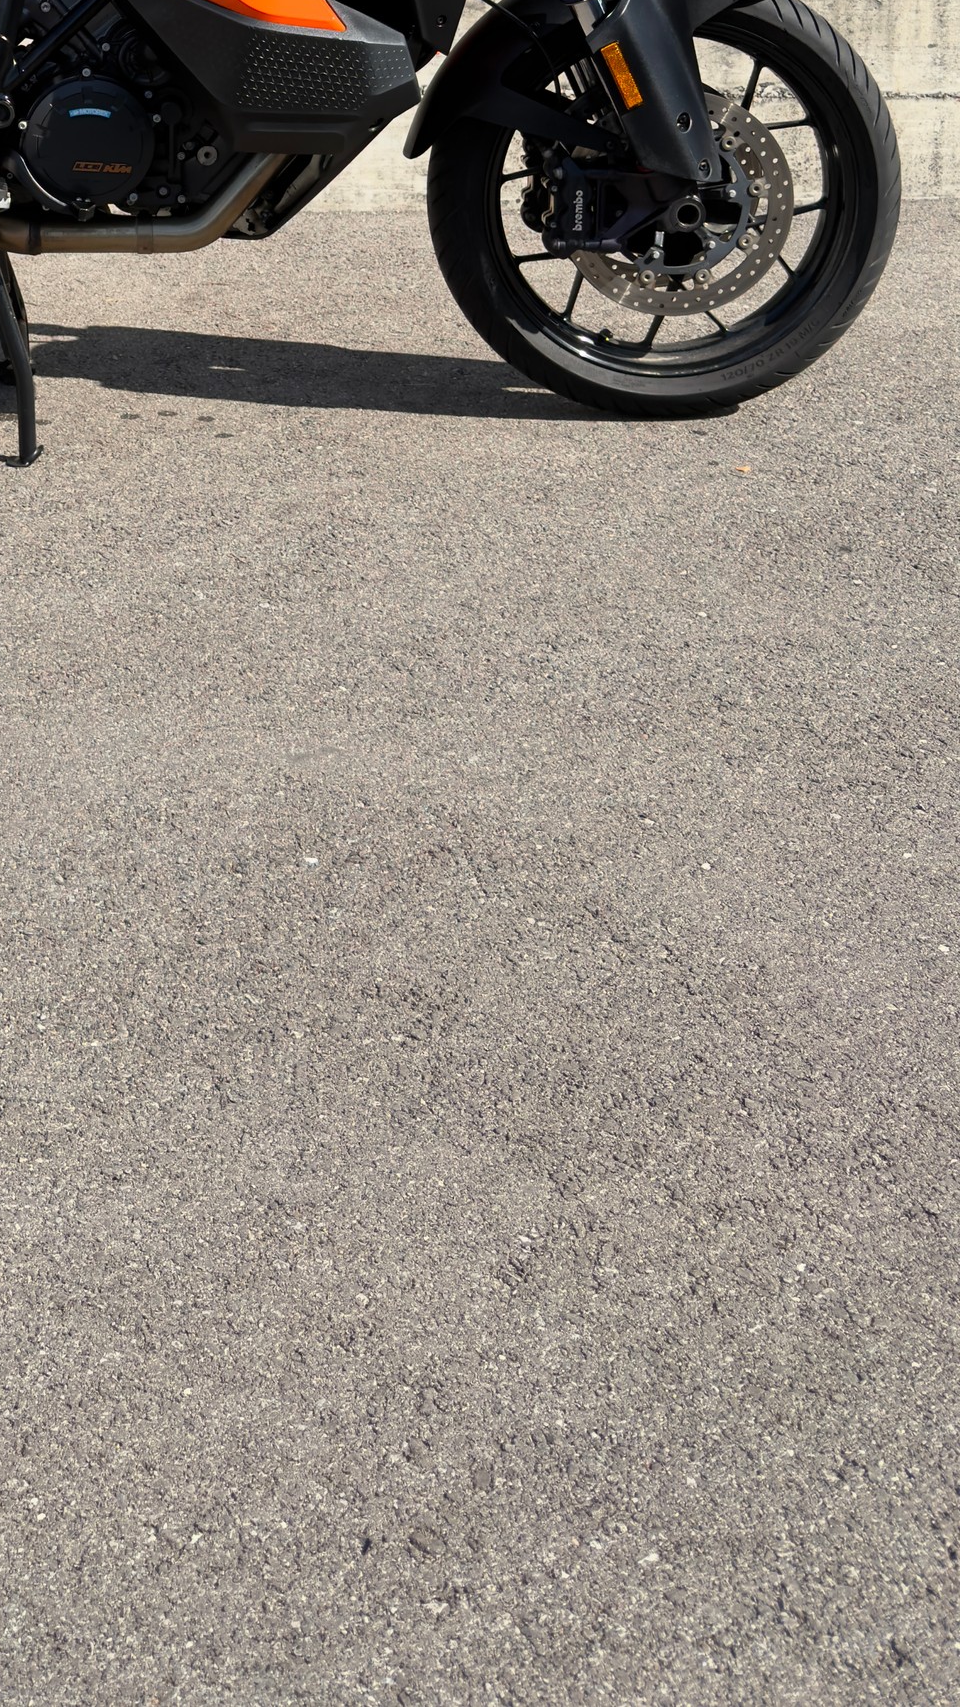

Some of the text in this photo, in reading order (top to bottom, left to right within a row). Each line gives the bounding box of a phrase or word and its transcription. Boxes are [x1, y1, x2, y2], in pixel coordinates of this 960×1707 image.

[103, 163, 132, 174] KTM
[572, 189, 583, 232] brembo
[720, 358, 765, 382] 120/70
[768, 347, 786, 362] ZR
